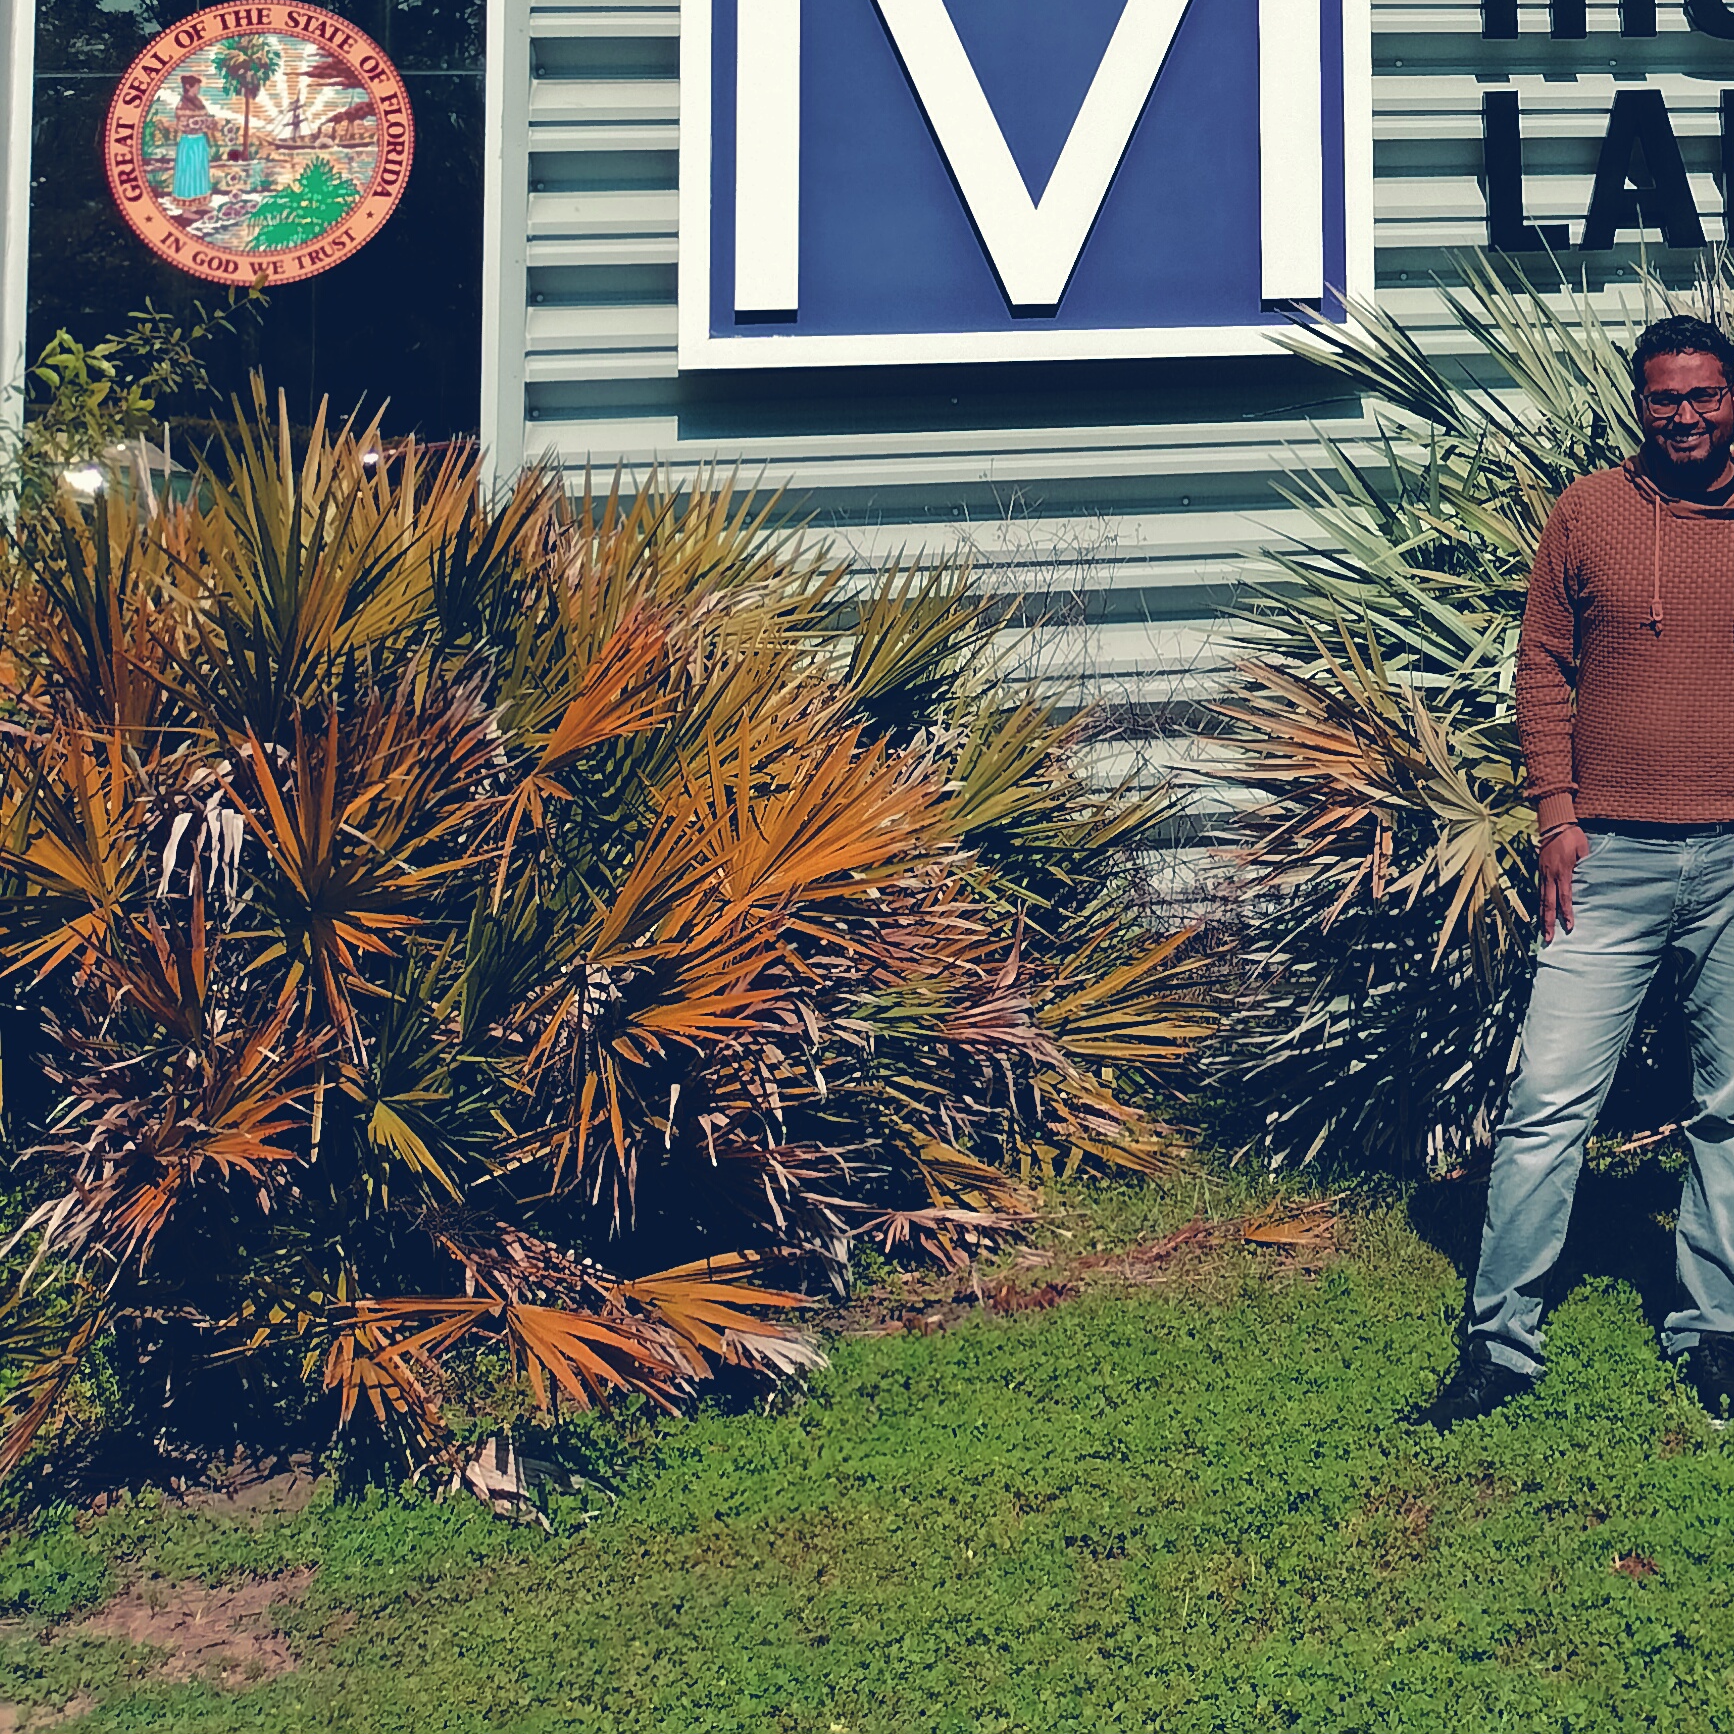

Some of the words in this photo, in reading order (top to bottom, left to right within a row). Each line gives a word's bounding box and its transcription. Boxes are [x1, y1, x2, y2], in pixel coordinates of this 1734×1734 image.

[173, 20, 207, 50] OF
[213, 7, 272, 31] THE
[284, 10, 359, 55] STATE
[122, 53, 174, 109] SEAL
[358, 55, 391, 86] OF
[113, 117, 144, 203] GREAT
[371, 92, 406, 200] FLORIDA
[160, 230, 187, 254] IN
[191, 251, 239, 276] GOD
[250, 261, 286, 277] WE
[293, 227, 357, 270] TRUST
